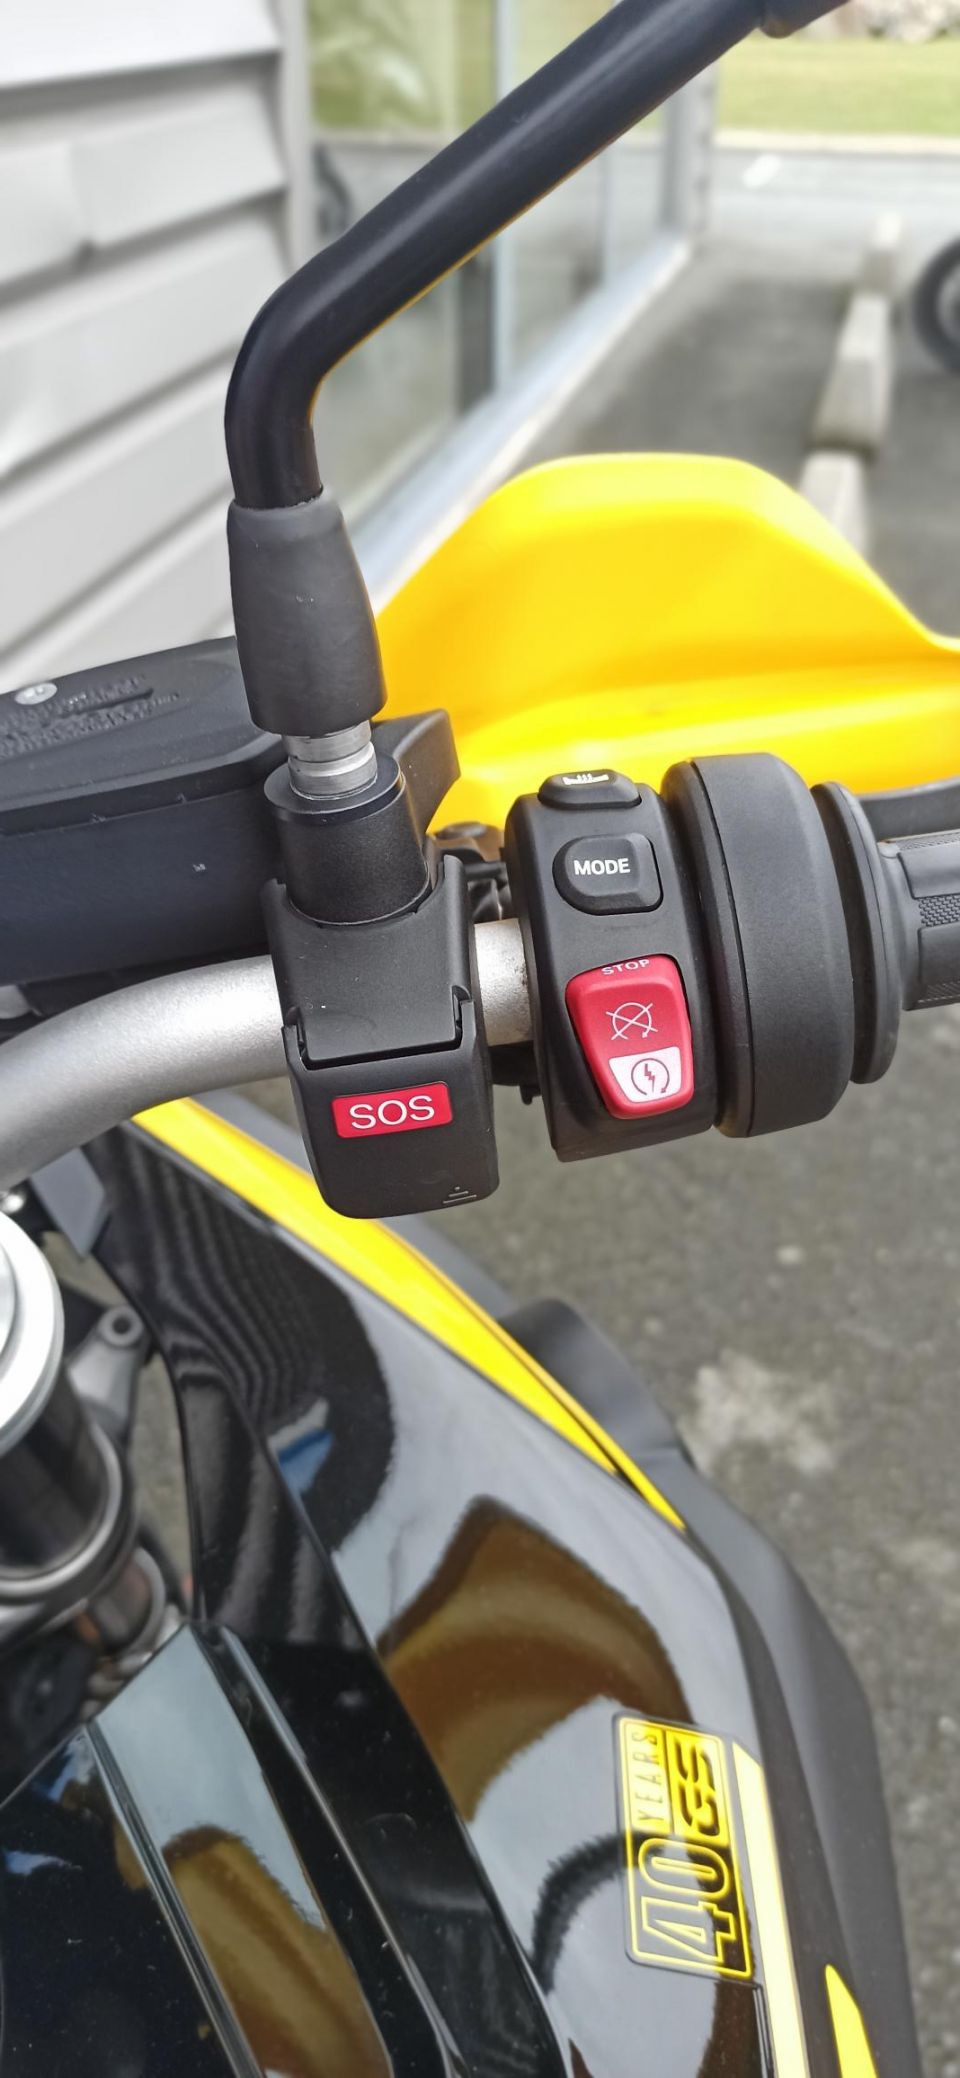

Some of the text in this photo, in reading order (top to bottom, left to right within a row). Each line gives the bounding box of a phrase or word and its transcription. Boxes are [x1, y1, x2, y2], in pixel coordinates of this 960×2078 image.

[574, 858, 631, 877] MODE
[601, 959, 651, 976] STOP
[350, 1095, 435, 1129] SOS
[631, 1731, 665, 1823] YEARS
[638, 1837, 737, 1964] 40
